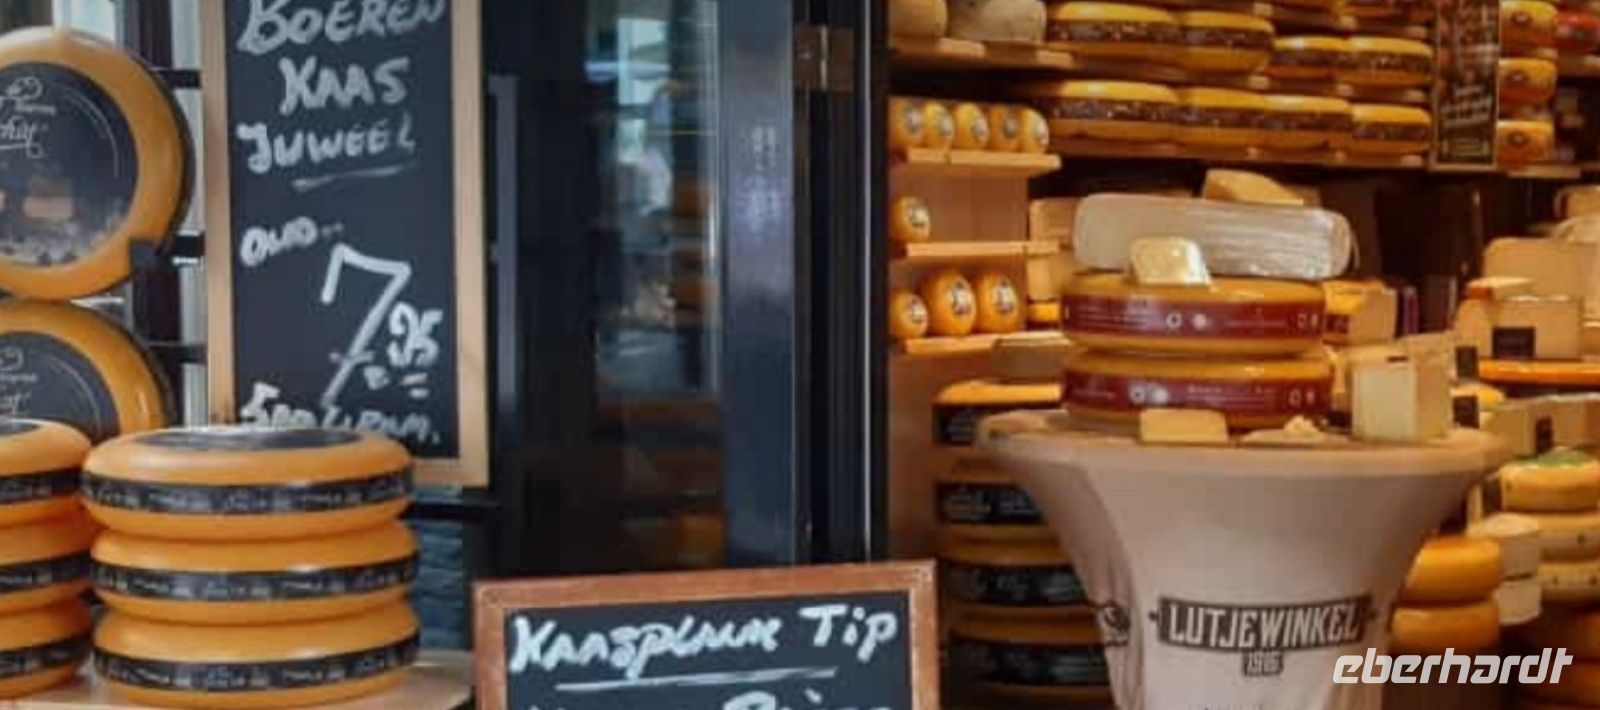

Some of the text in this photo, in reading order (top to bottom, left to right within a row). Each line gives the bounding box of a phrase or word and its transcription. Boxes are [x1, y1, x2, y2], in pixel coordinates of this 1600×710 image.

[237, 0, 446, 55] BOEREN
[279, 56, 410, 115] KAAS
[798, 604, 897, 662] Tip
[1168, 602, 1361, 649] LUTJEWINKEL
